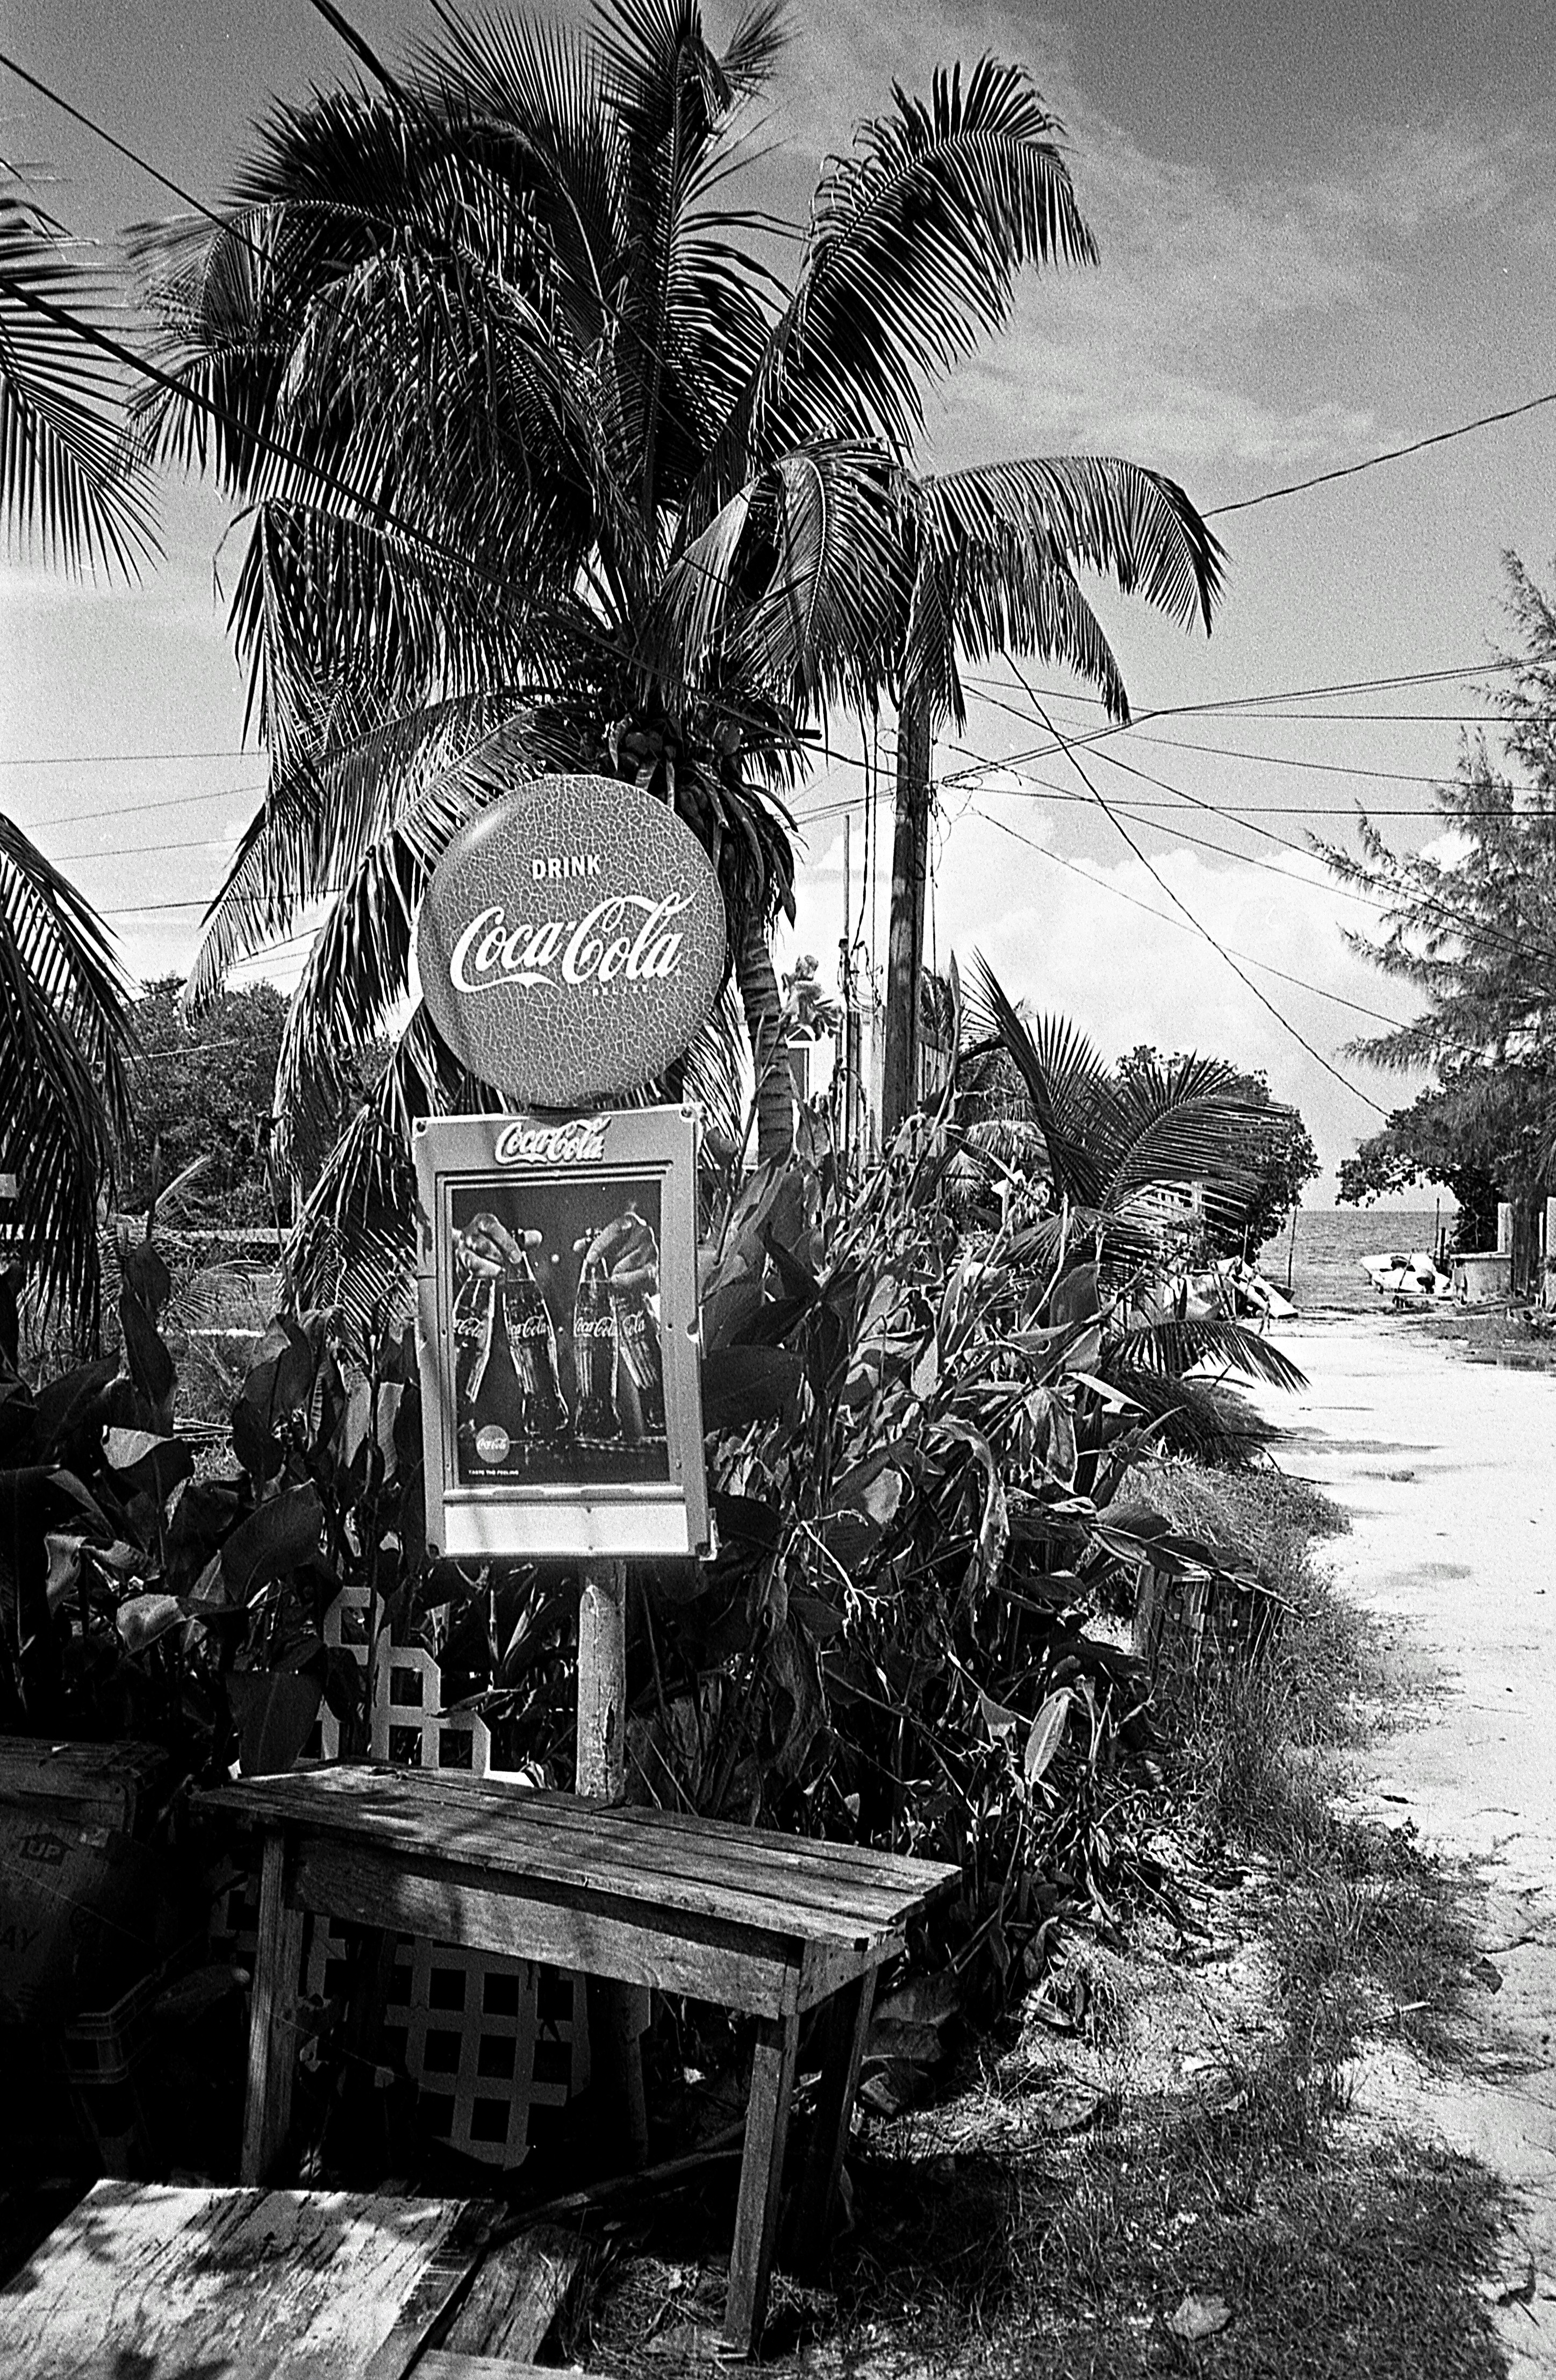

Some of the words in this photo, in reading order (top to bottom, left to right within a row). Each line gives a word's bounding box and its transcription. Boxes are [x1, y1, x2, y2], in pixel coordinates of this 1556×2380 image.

[533, 855, 601, 879] DRINK
[450, 892, 696, 993] Coca-Cola
[495, 1116, 611, 1165] Coca-Cola
[28, 1840, 61, 1859] UP
